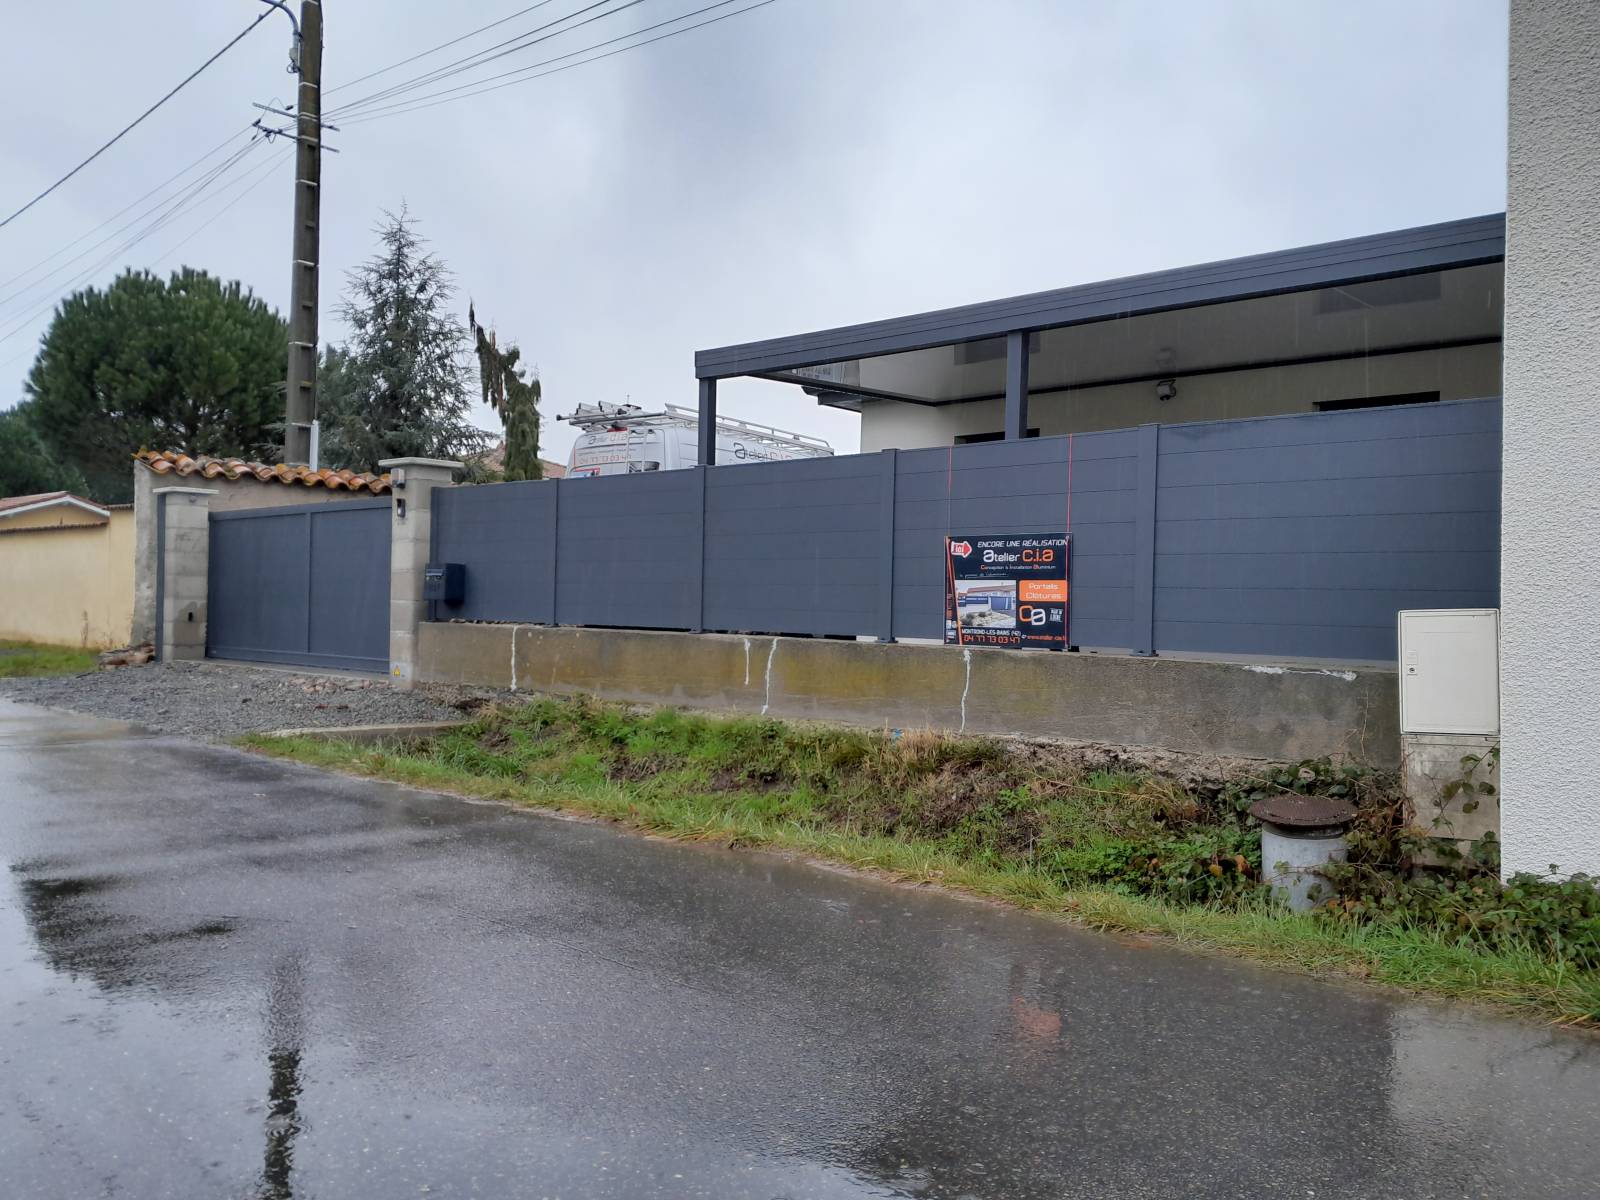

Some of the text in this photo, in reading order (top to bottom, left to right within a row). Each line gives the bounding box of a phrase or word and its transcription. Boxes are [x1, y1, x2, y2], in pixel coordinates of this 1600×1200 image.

[977, 540, 1005, 548] ENCORE
[1022, 538, 1067, 547] RÉALISATION
[983, 549, 1020, 562] atelier
[963, 634, 974, 642] 04
[977, 634, 986, 642] 77
[989, 635, 997, 643] 73
[997, 635, 1009, 643] 03
[1010, 635, 1021, 643] 47
